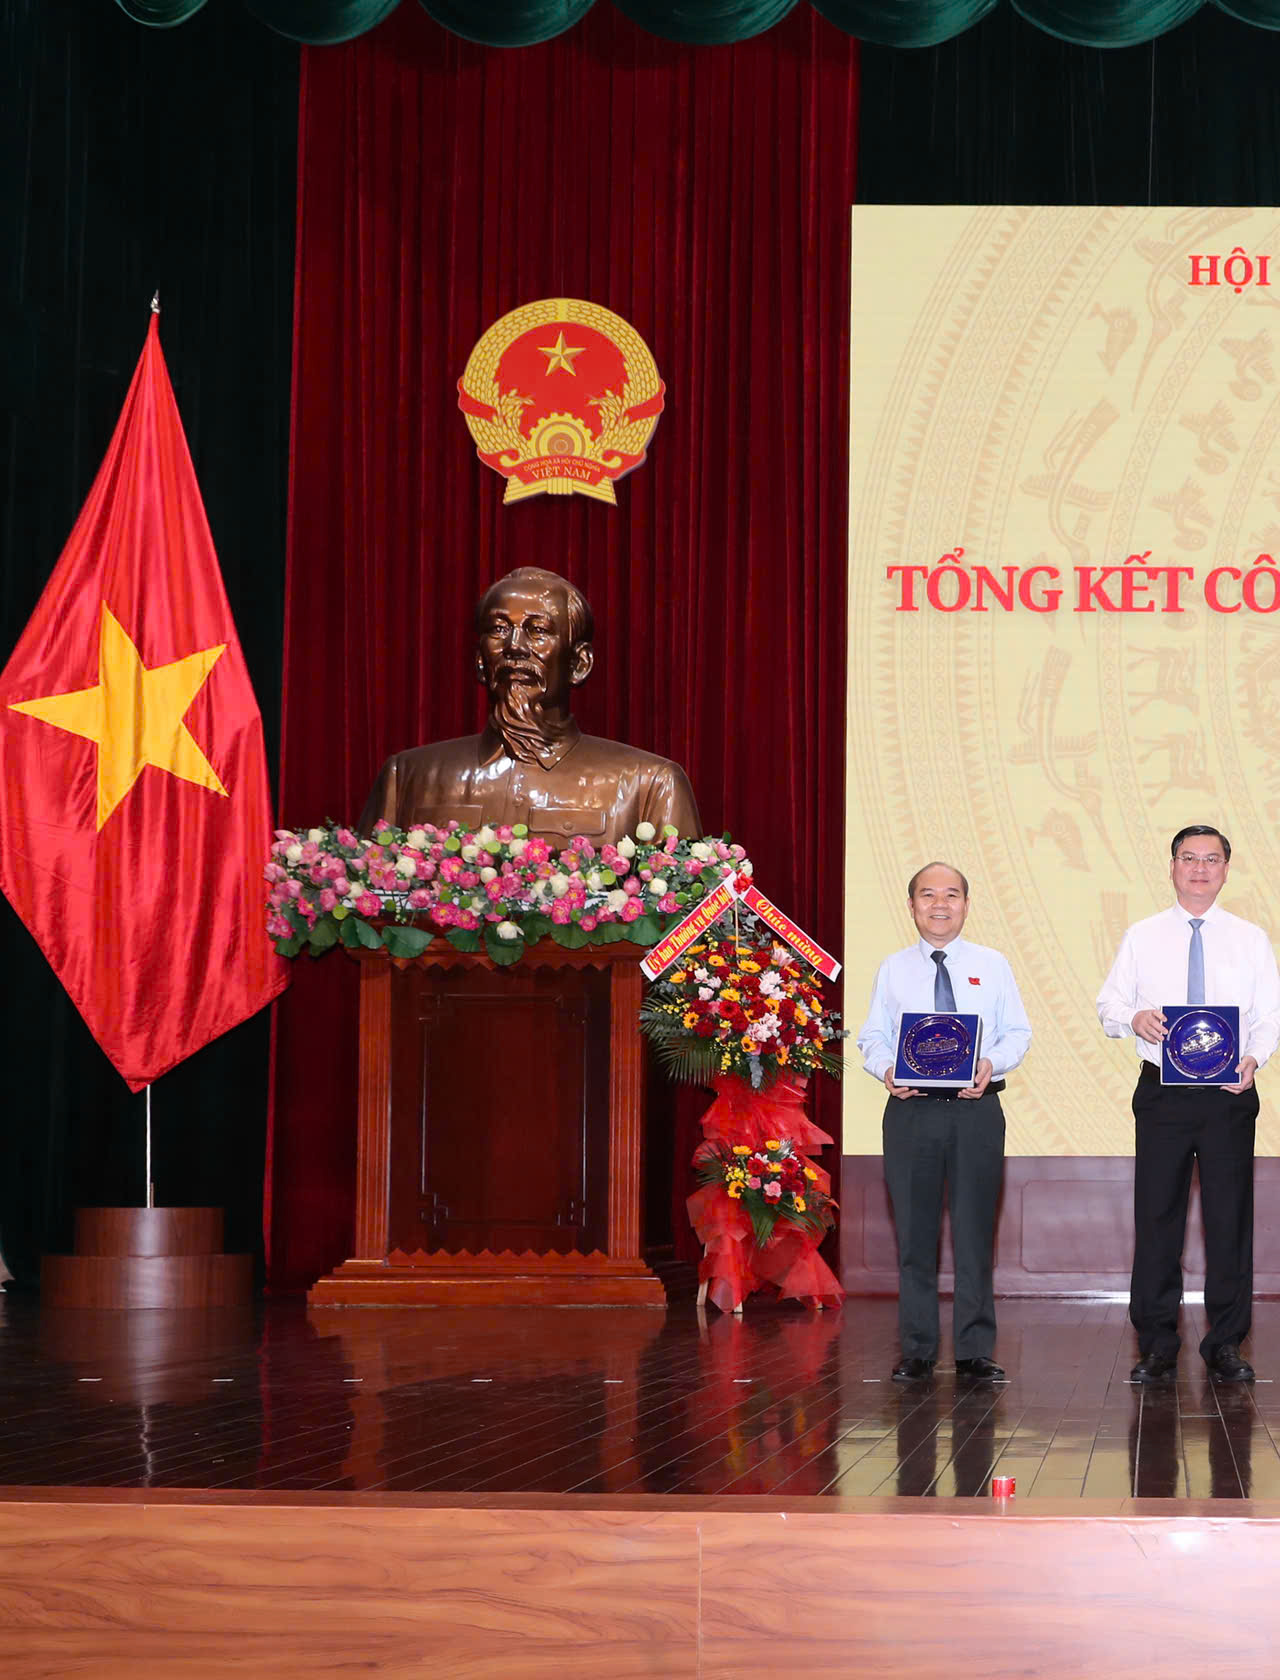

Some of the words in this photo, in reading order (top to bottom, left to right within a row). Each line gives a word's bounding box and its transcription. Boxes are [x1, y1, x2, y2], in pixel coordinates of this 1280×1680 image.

[1188, 247, 1270, 294] HỘI
[531, 464, 560, 479] VIỆT
[563, 466, 591, 481] NAM
[887, 547, 1063, 614] TỔNG
[1073, 550, 1194, 613] KẾT
[755, 899, 787, 931] Chúc
[786, 930, 823, 967] mừng
